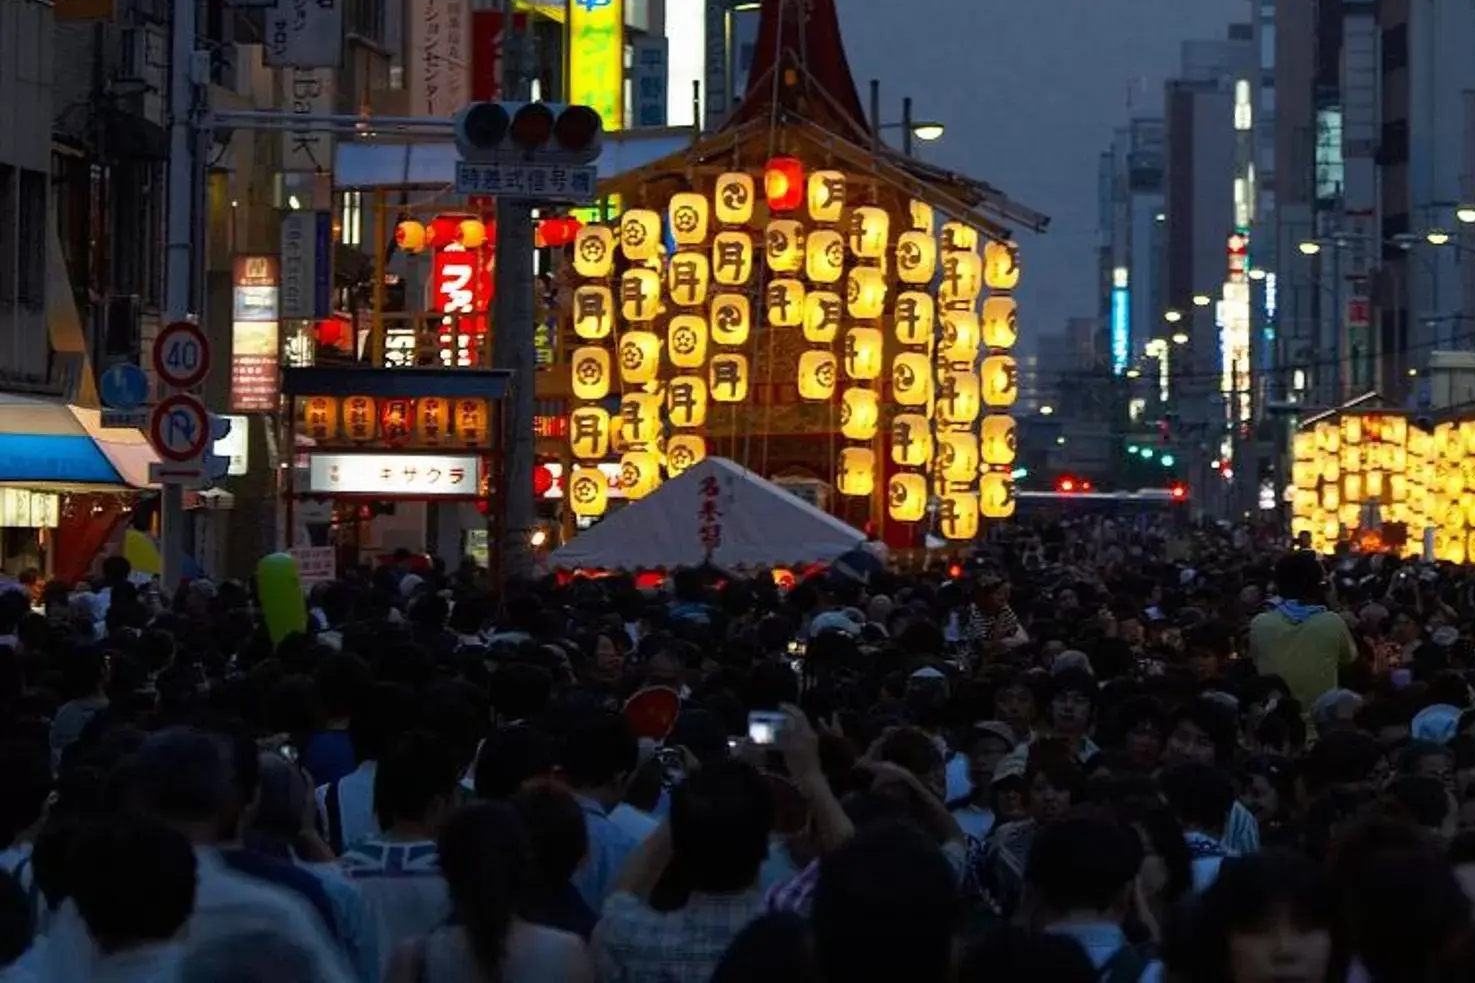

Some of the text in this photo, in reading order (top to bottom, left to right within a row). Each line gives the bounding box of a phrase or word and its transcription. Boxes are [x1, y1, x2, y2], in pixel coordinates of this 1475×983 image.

[673, 260, 701, 302] 月
[717, 240, 746, 281] 月
[578, 292, 607, 334] 月
[168, 341, 198, 370] 40
[714, 360, 741, 397] 月
[669, 382, 697, 423] 月
[573, 414, 603, 454] 月
